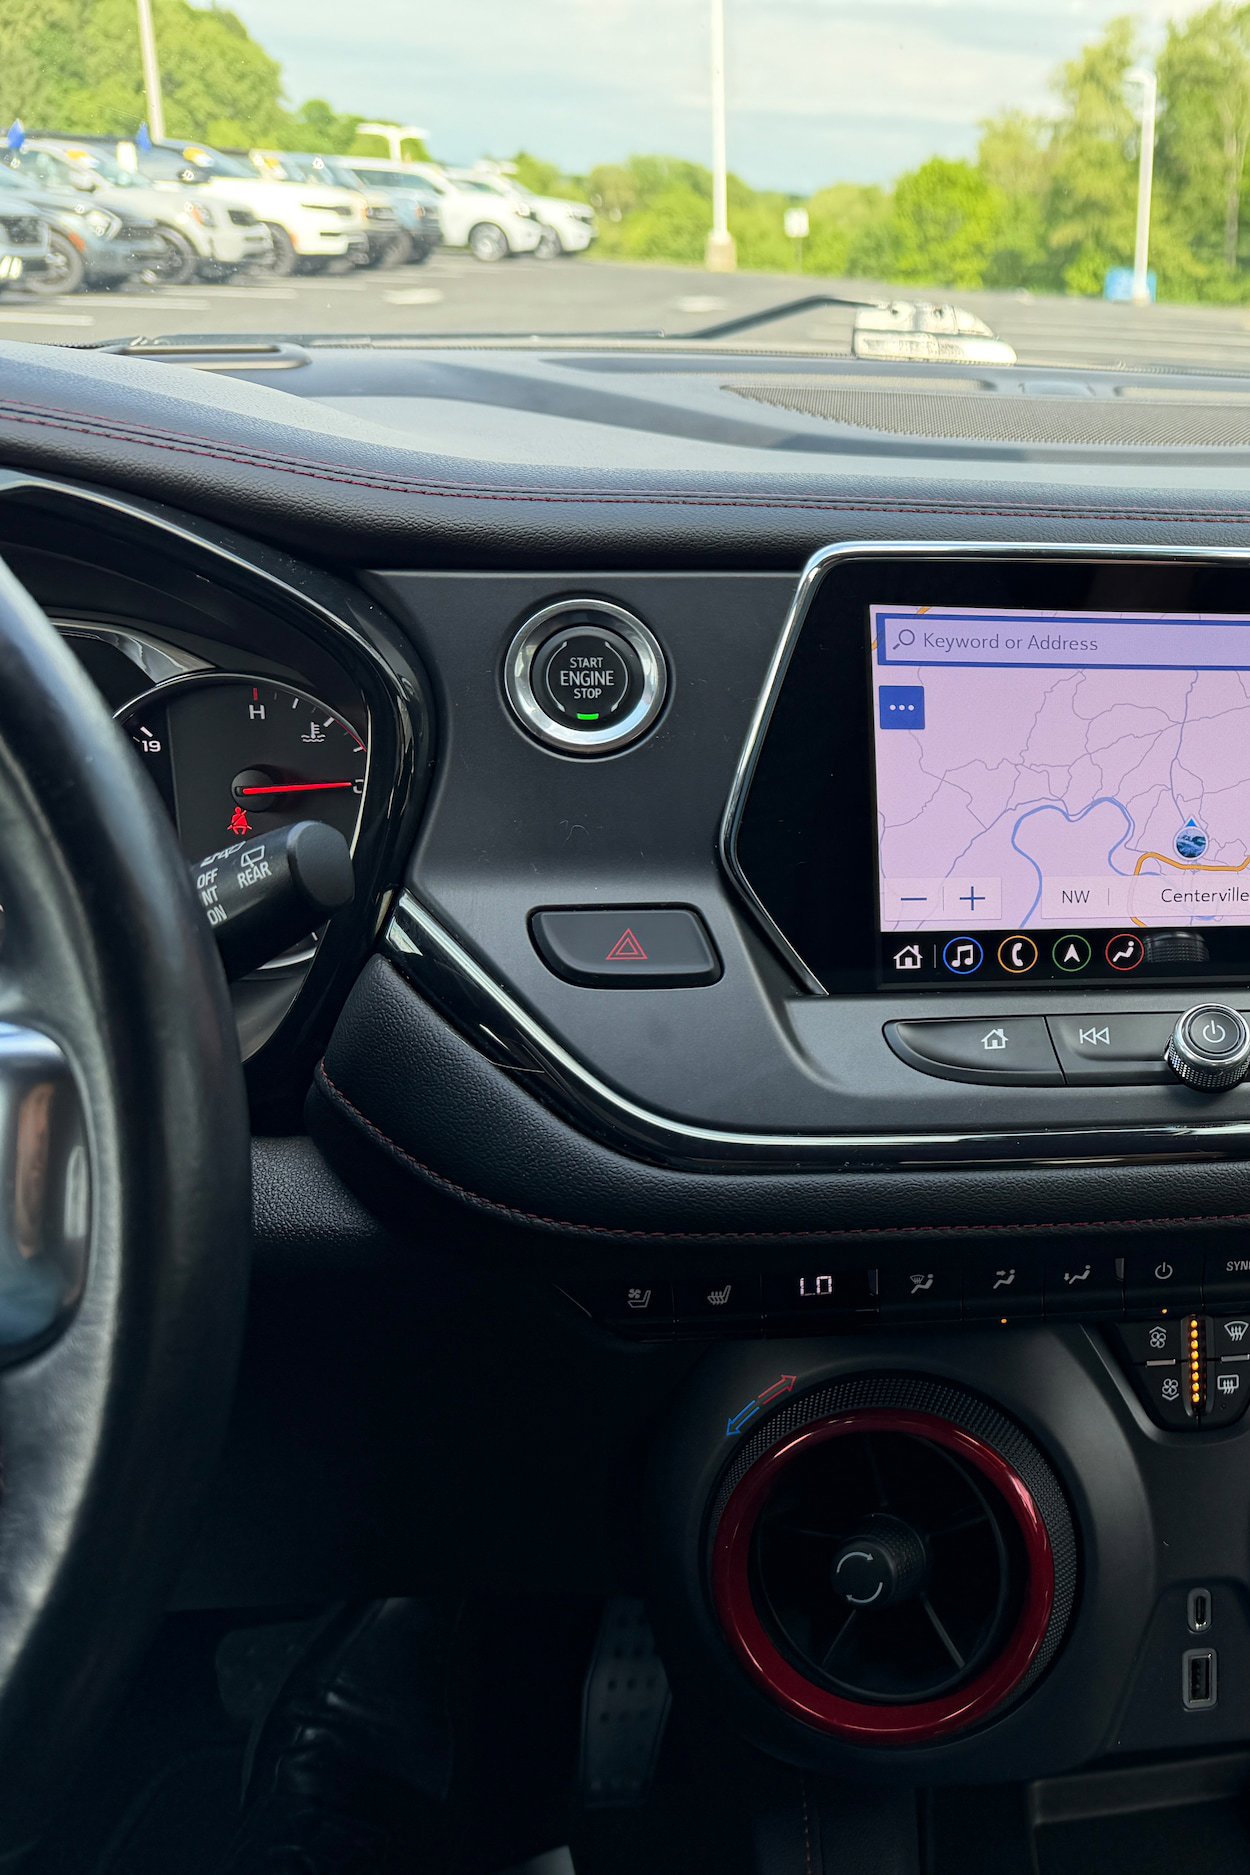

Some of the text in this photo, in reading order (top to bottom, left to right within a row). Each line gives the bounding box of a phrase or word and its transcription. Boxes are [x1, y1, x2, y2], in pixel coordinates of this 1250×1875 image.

[923, 632, 1098, 653] Keyword or Address
[569, 656, 604, 669] START
[560, 670, 615, 686] ENGINE
[573, 687, 603, 699] STOP
[249, 704, 266, 720] H
[141, 740, 162, 753] 19
[196, 867, 219, 890] OFF
[236, 860, 273, 890] REAR
[198, 885, 219, 907] NT
[1061, 889, 1091, 904] NW
[206, 904, 228, 926] ON
